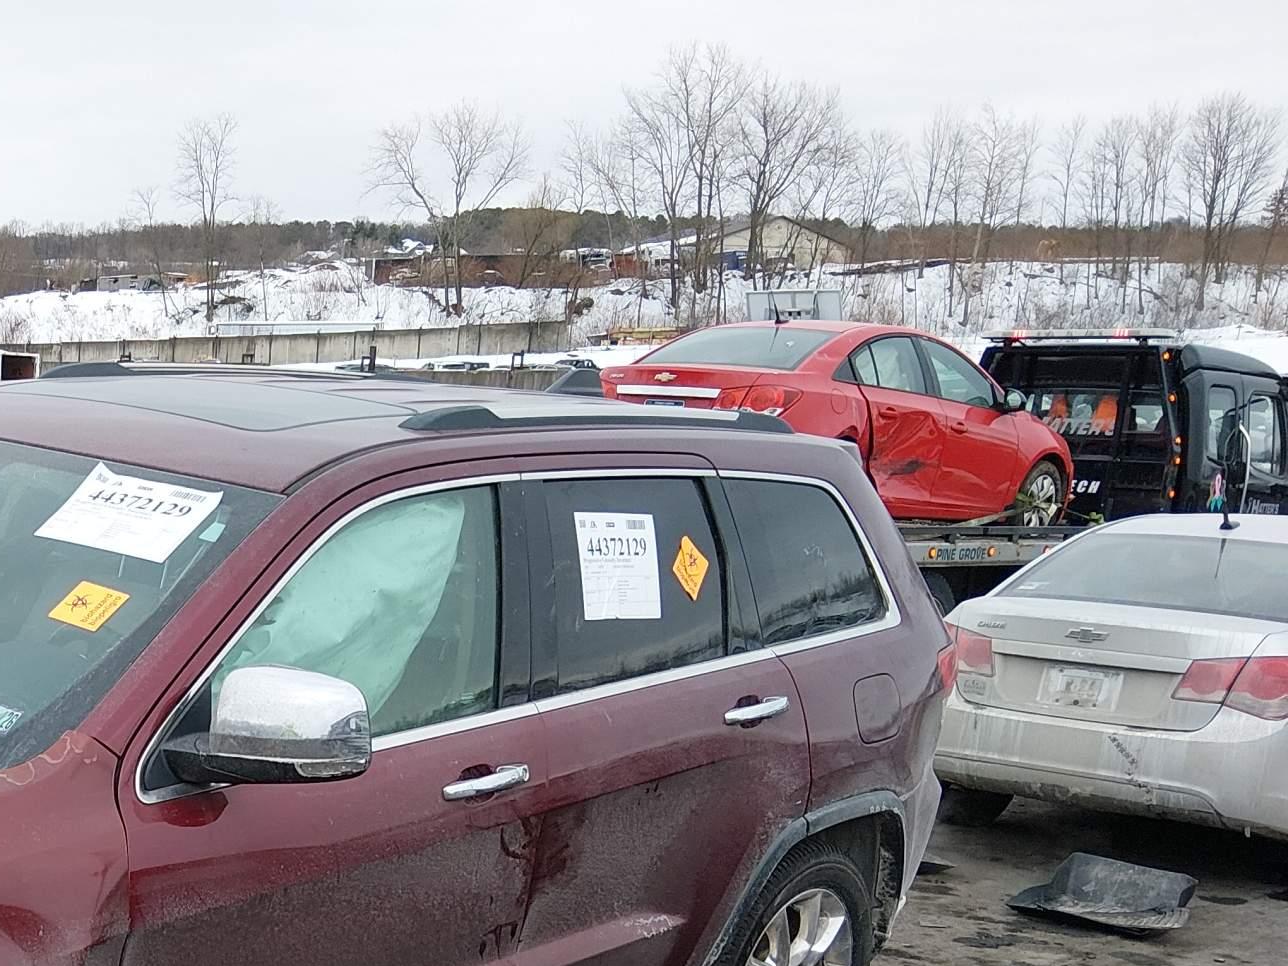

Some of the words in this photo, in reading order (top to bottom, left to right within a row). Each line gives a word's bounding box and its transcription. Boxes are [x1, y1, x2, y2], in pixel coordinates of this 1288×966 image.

[88, 488, 192, 518] 44372129
[586, 536, 647, 557] 44372129
[936, 548, 957, 561] PINE
[959, 547, 987, 561] GROVE
